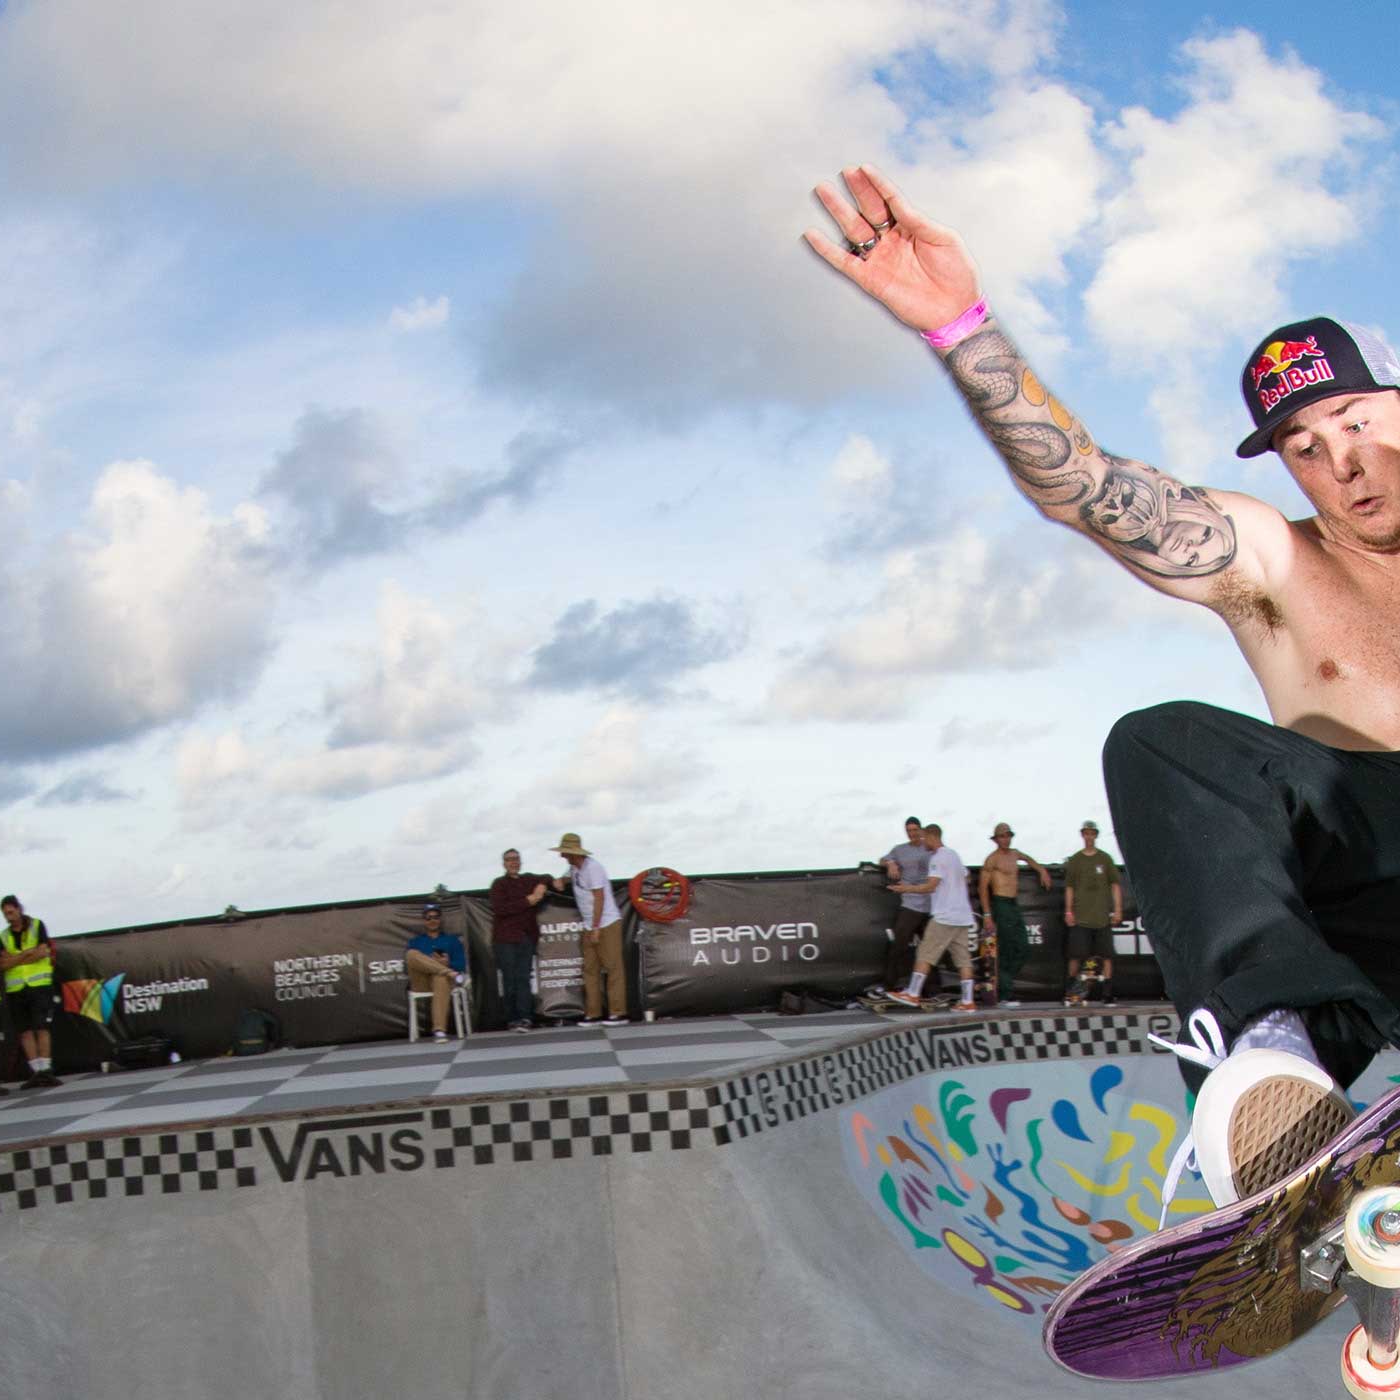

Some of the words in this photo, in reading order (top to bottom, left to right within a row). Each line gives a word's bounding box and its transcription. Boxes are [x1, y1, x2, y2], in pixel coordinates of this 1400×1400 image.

[1258, 373, 1291, 415] Red
[1287, 358, 1335, 393] Bull
[689, 921, 819, 946] BRAVEN
[273, 953, 353, 973] NORTHERN
[692, 943, 821, 967] AUDIO
[122, 976, 210, 999] Destination
[274, 969, 341, 987] BEACHES
[275, 984, 338, 1001] COUNCIL
[123, 996, 163, 1014] NSW
[915, 1022, 993, 1074] VANS
[257, 1111, 427, 1185] VANS
